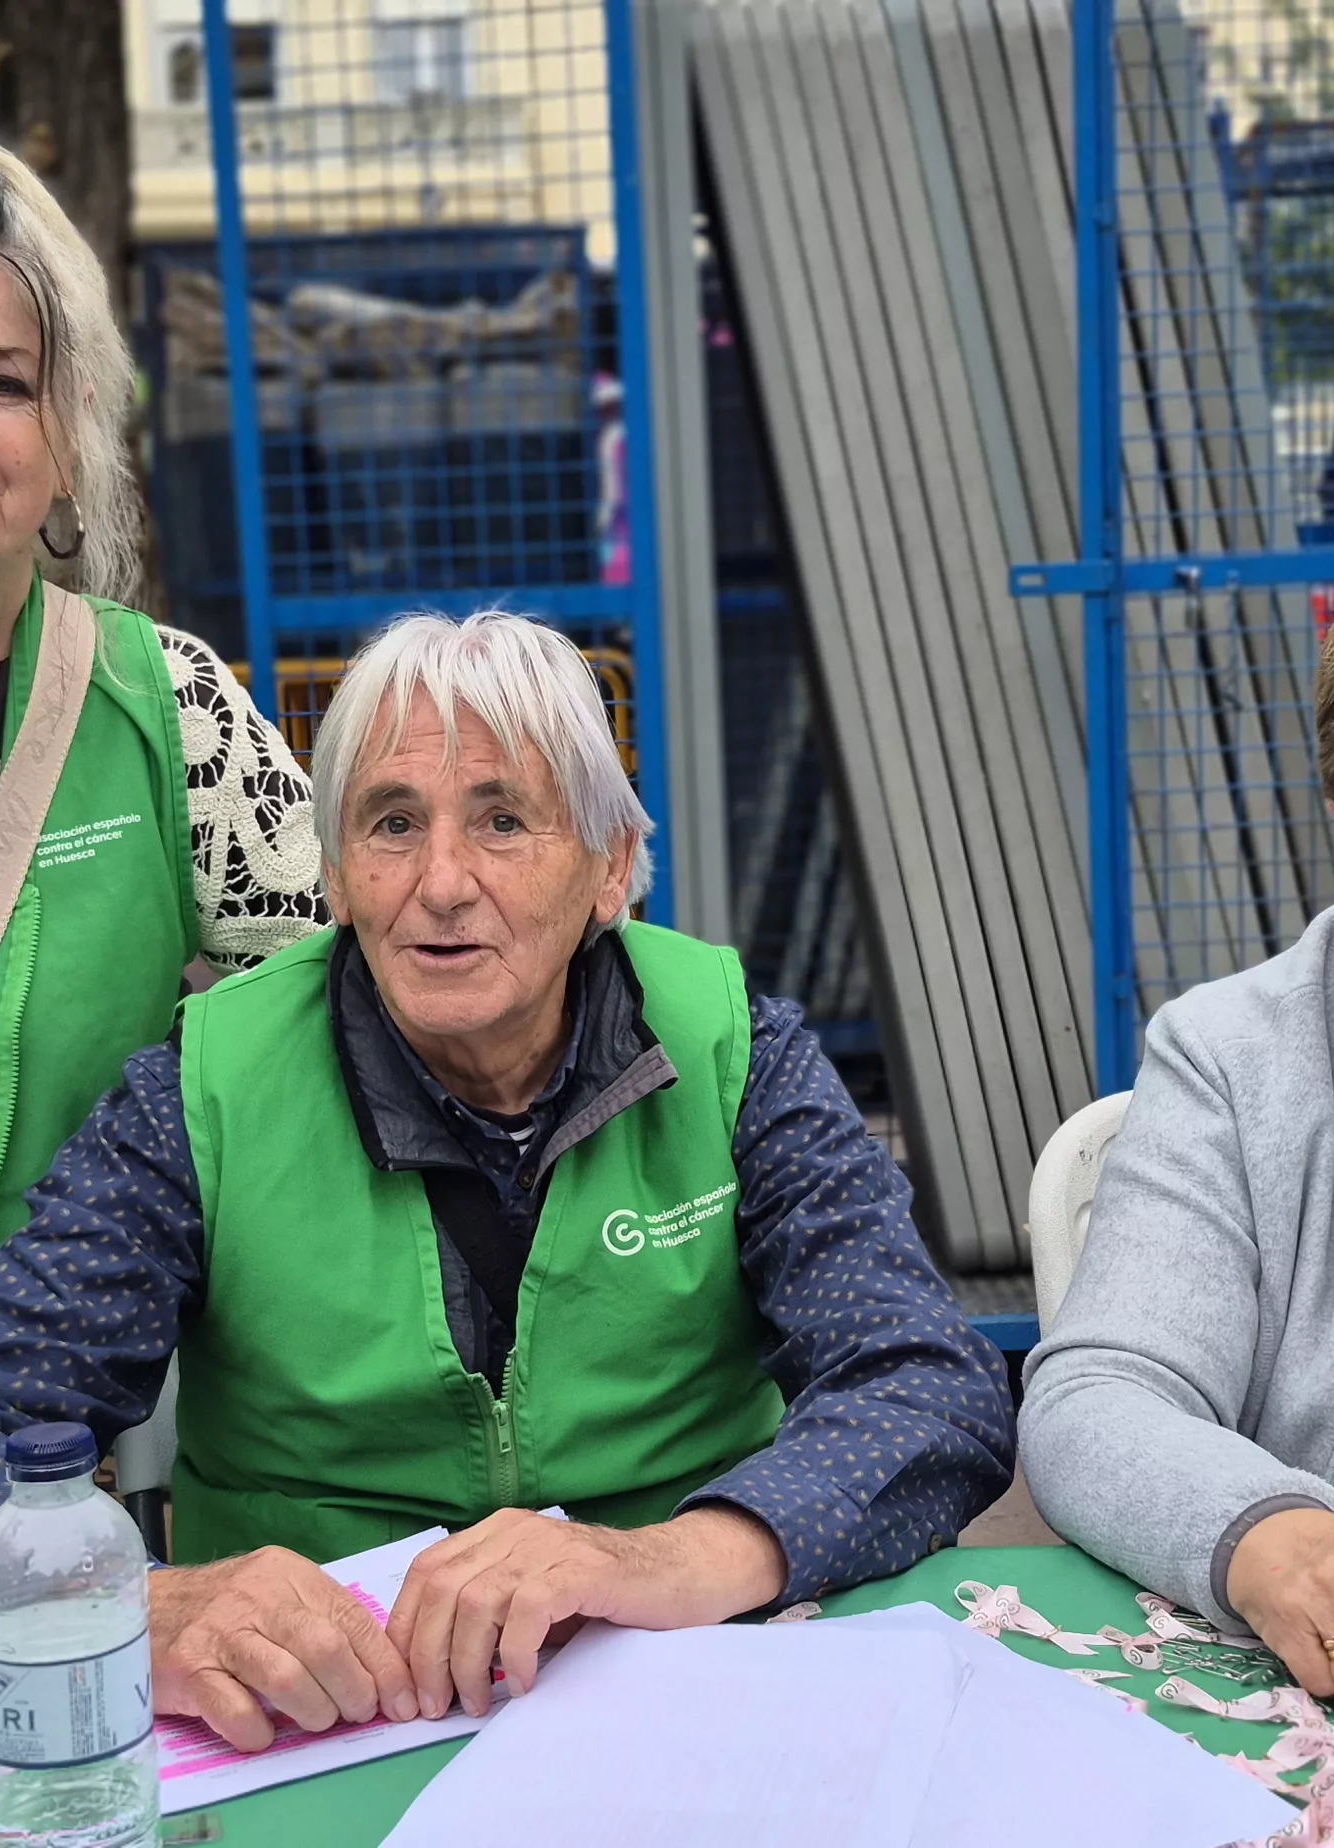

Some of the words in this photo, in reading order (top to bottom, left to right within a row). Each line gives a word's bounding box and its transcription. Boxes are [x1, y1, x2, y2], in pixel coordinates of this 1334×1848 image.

[93, 813, 142, 831] española
[36, 842, 73, 857] contra
[74, 837, 84, 848] el
[85, 830, 124, 845] cáncer
[38, 858, 53, 869] en
[54, 848, 96, 865] Huesca
[693, 1181, 737, 1207] española
[678, 1215, 688, 1229] el
[688, 1202, 724, 1223] cáncer
[662, 1227, 701, 1248] Huesca
